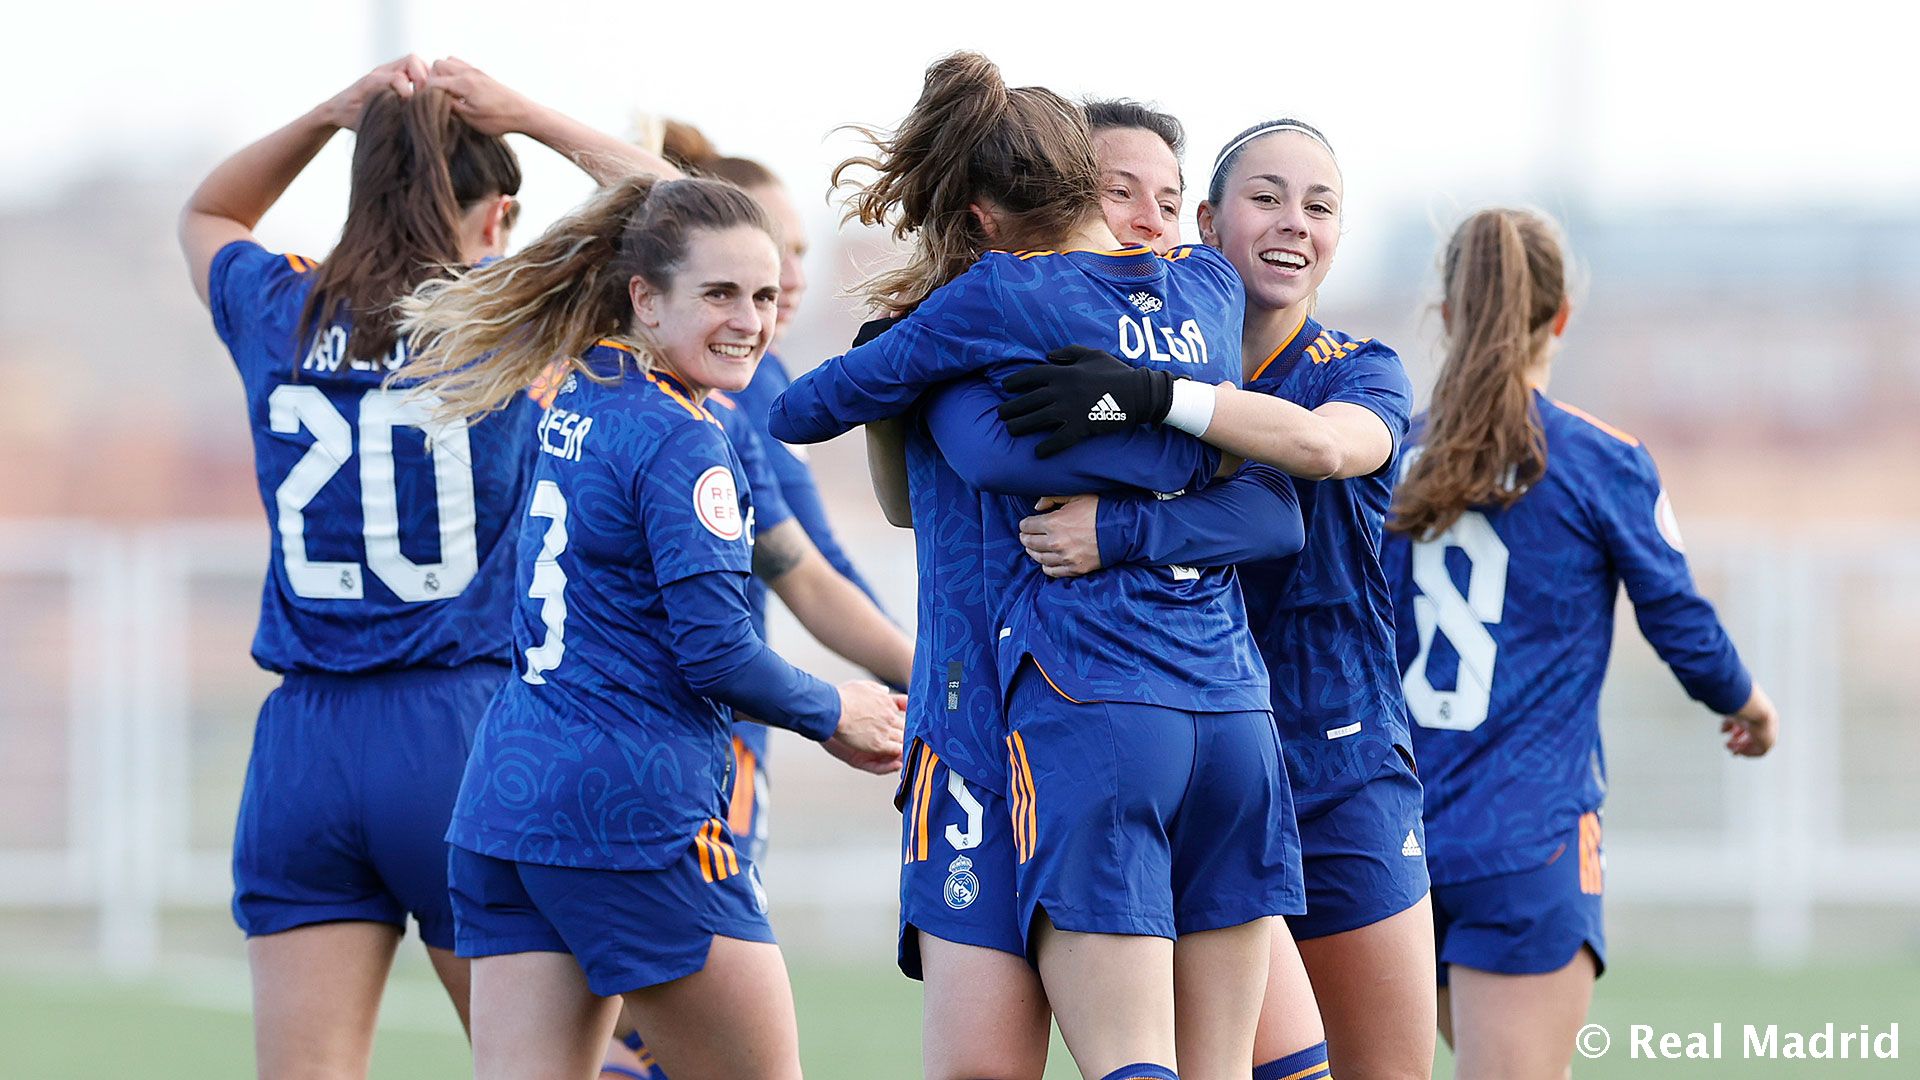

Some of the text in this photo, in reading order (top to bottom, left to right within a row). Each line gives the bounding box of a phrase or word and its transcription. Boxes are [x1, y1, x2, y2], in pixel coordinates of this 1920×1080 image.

[1088, 410, 1127, 421] adidas
[1118, 314, 1208, 364] OLGA
[268, 384, 478, 603] 20
[521, 480, 568, 685] 3
[1403, 511, 1509, 732] 8
